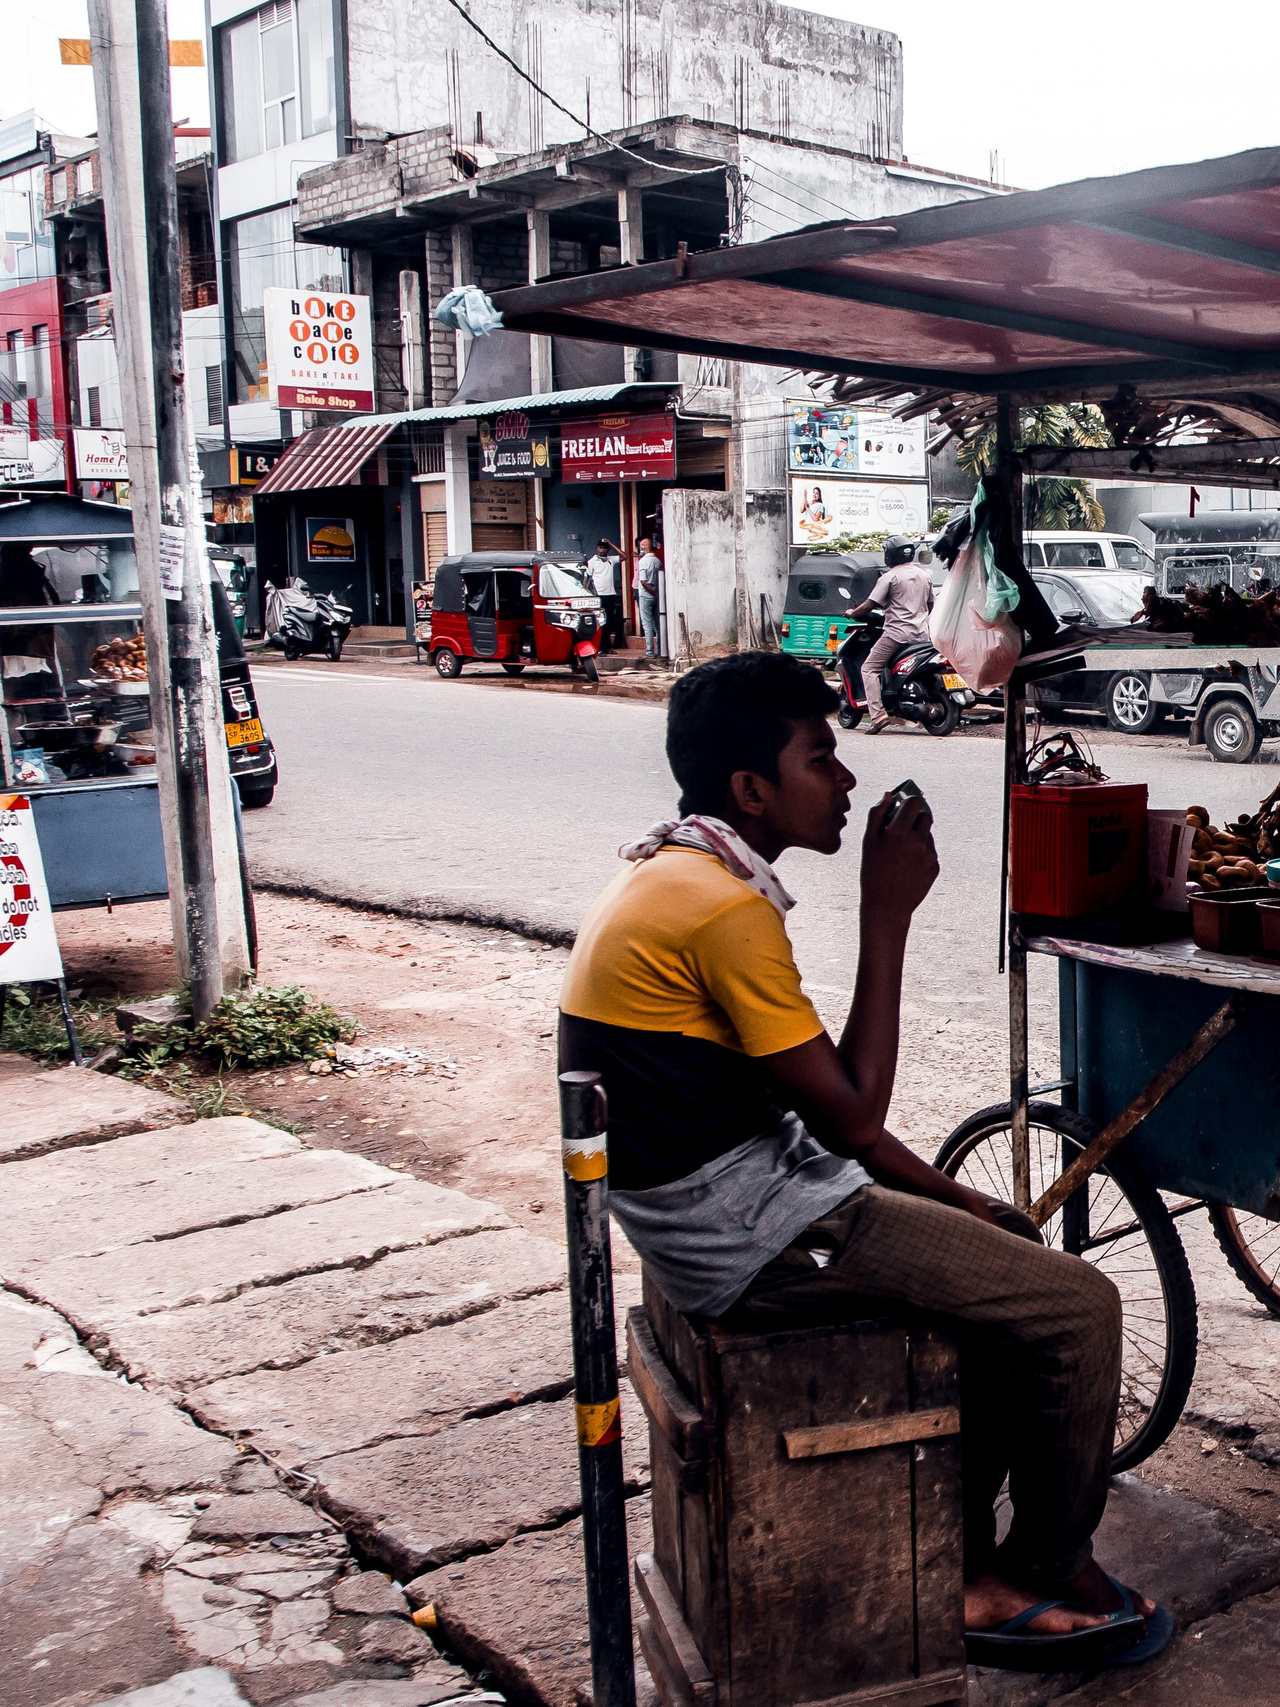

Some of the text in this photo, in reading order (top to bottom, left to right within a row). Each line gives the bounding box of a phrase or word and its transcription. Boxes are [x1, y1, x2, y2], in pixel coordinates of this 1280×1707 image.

[291, 369, 318, 378] BAKE
[334, 372, 359, 381] TAKE
[296, 393, 356, 409] Bake Shop
[561, 436, 626, 459] FREELAN
[86, 453, 114, 464] Home
[517, 451, 531, 465] FOOD
[311, 547, 352, 556] Bake Shop
[239, 721, 257, 733] AAU
[228, 731, 260, 743] SP 3695
[3, 896, 39, 914] do not
